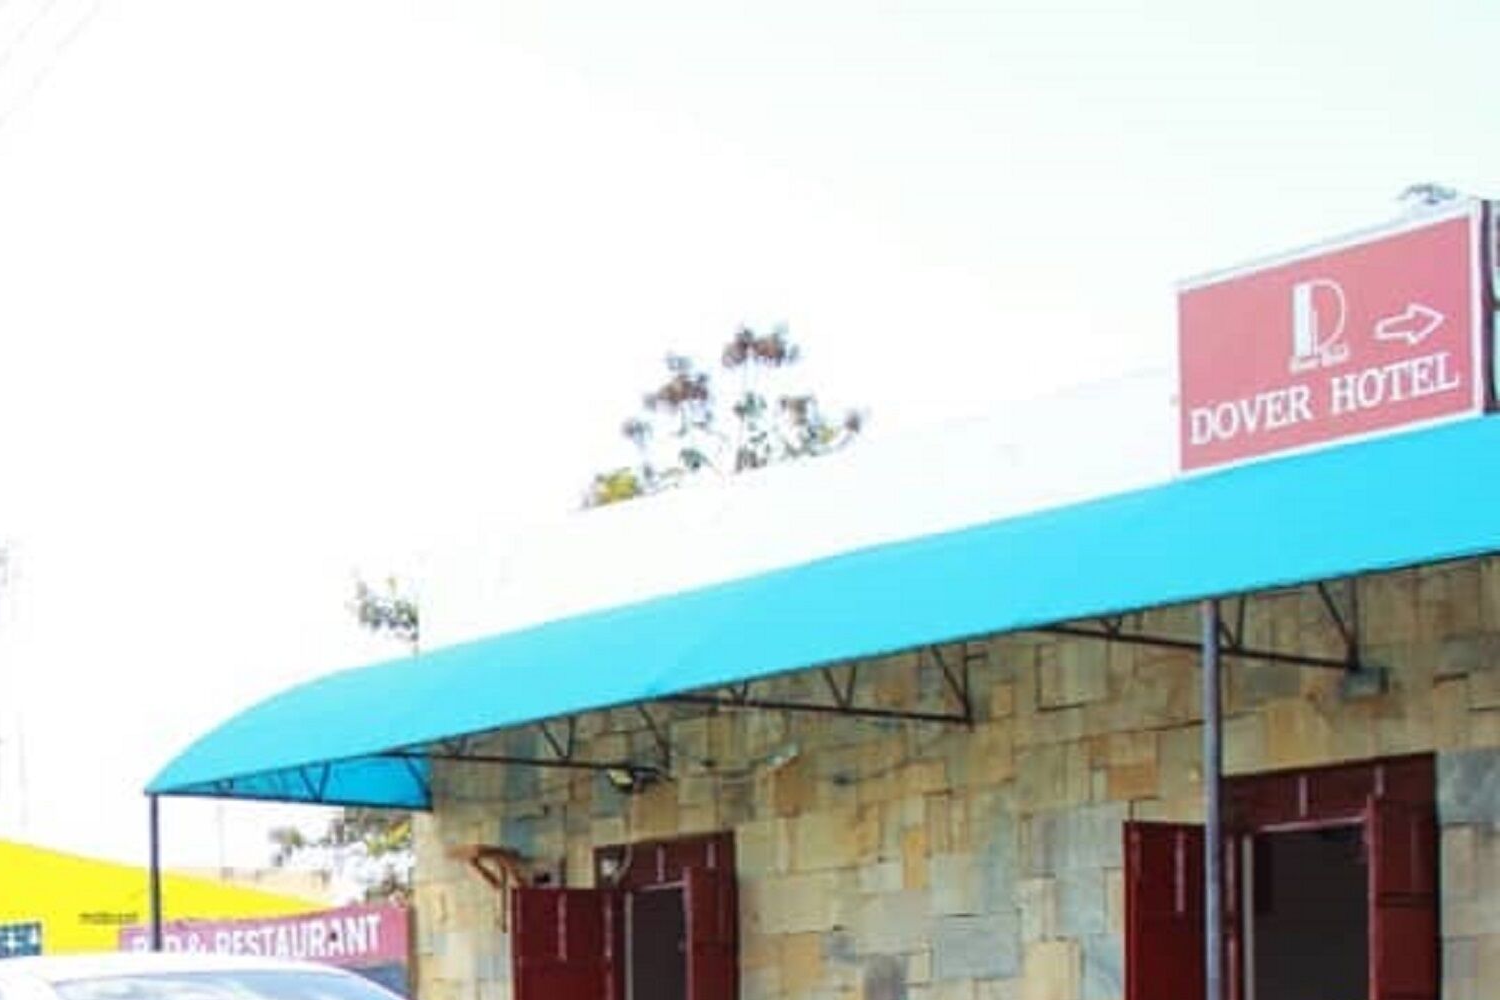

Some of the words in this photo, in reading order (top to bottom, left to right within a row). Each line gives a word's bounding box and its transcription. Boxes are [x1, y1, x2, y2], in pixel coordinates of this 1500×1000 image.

[1190, 385, 1313, 445] DOVER
[1331, 352, 1460, 415] HOTEL
[215, 914, 381, 957] RESTAURANT
